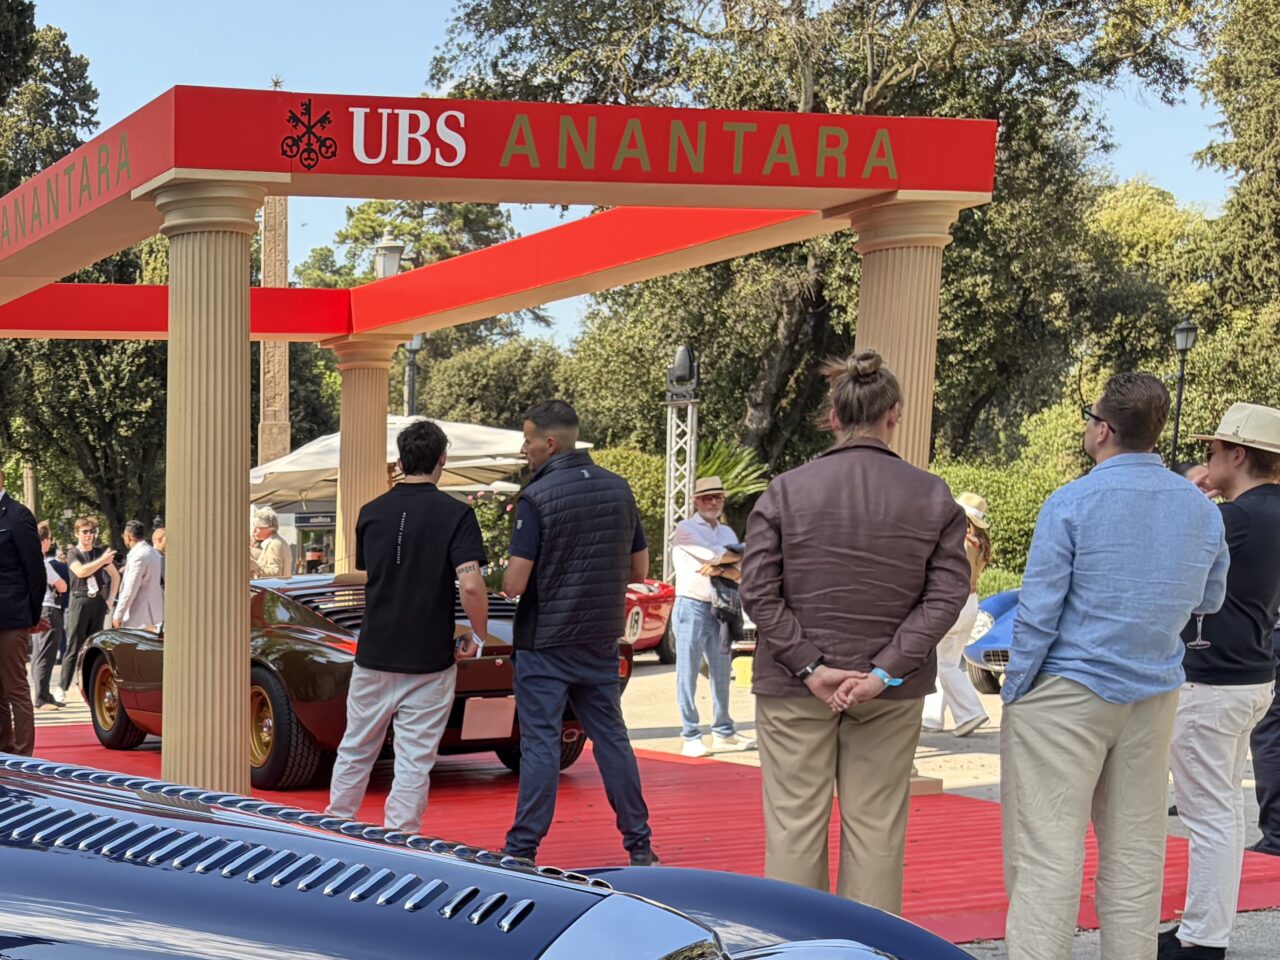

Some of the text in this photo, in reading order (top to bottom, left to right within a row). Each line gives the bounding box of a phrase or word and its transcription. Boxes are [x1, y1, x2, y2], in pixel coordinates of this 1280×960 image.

[350, 107, 899, 180] UBS ANANTARA
[0, 131, 131, 249] ANANTARA
[628, 610, 640, 638] 18
